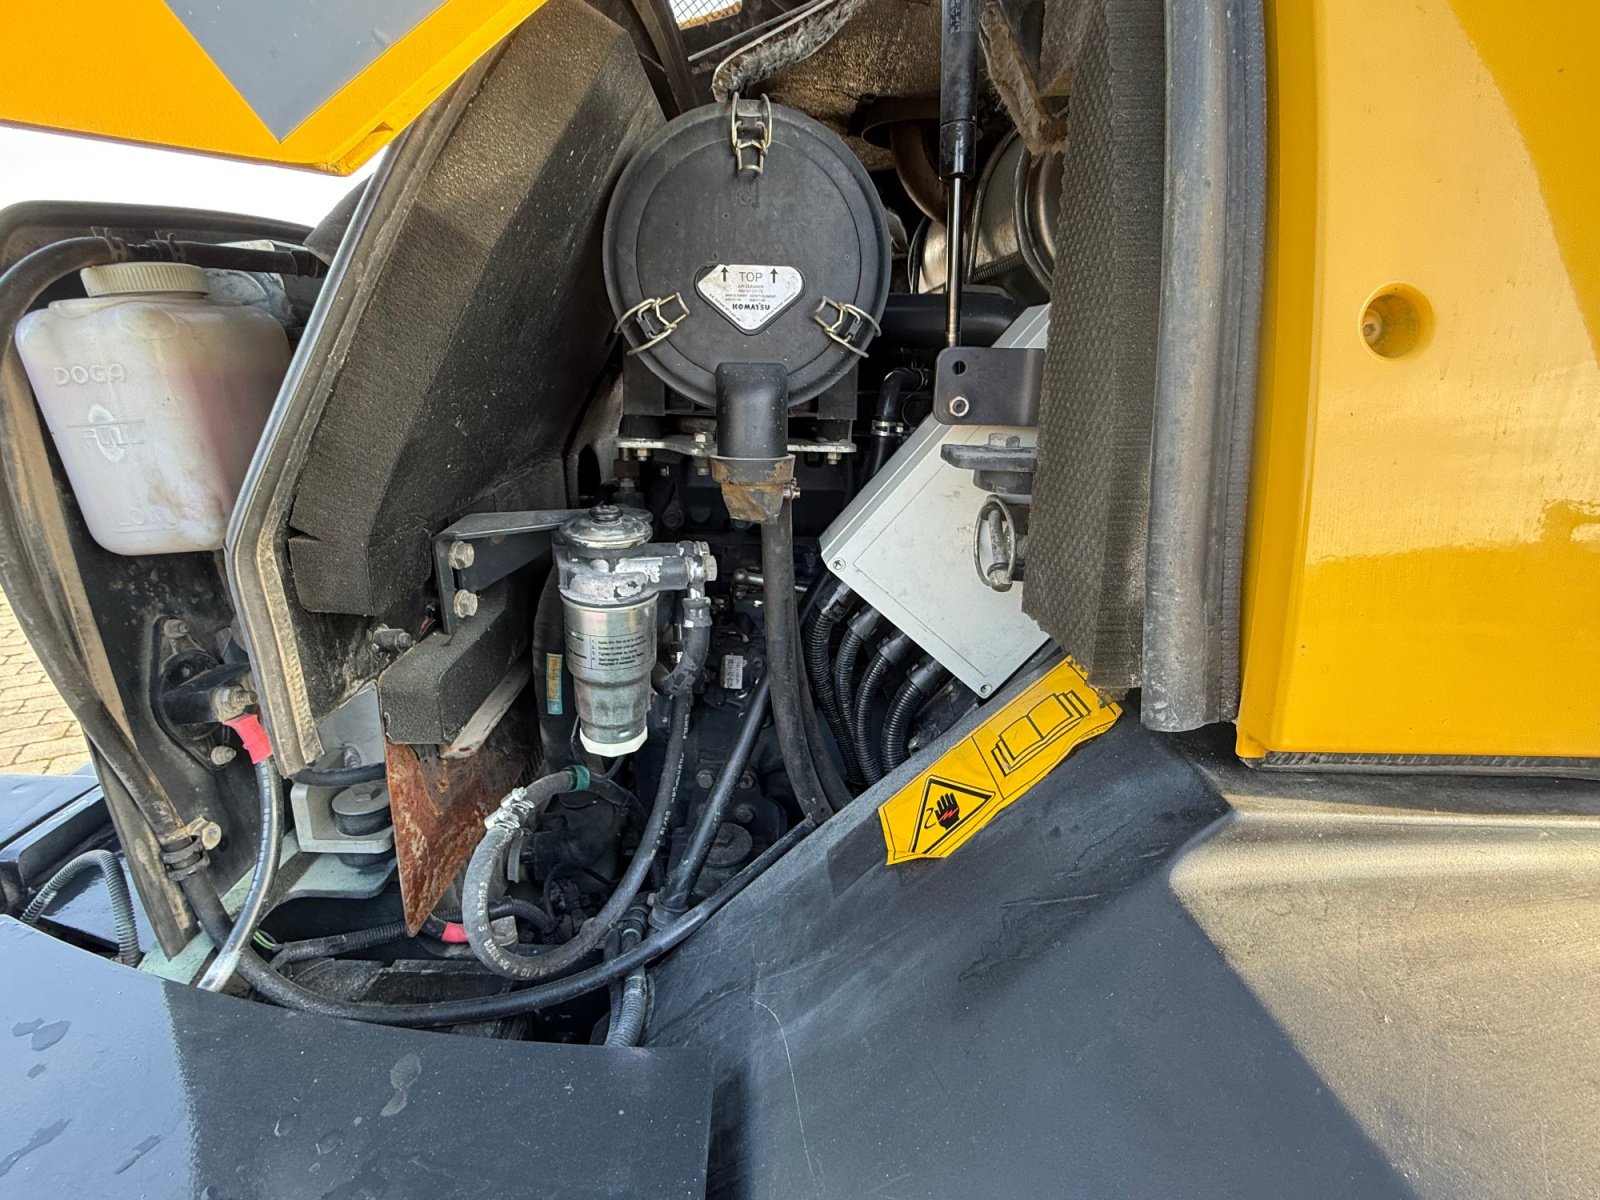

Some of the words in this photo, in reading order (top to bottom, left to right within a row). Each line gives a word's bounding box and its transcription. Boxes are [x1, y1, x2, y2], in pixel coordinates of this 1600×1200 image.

[739, 272, 762, 282] TOP
[732, 303, 770, 311] KOMATSU
[53, 363, 126, 386] DOGA
